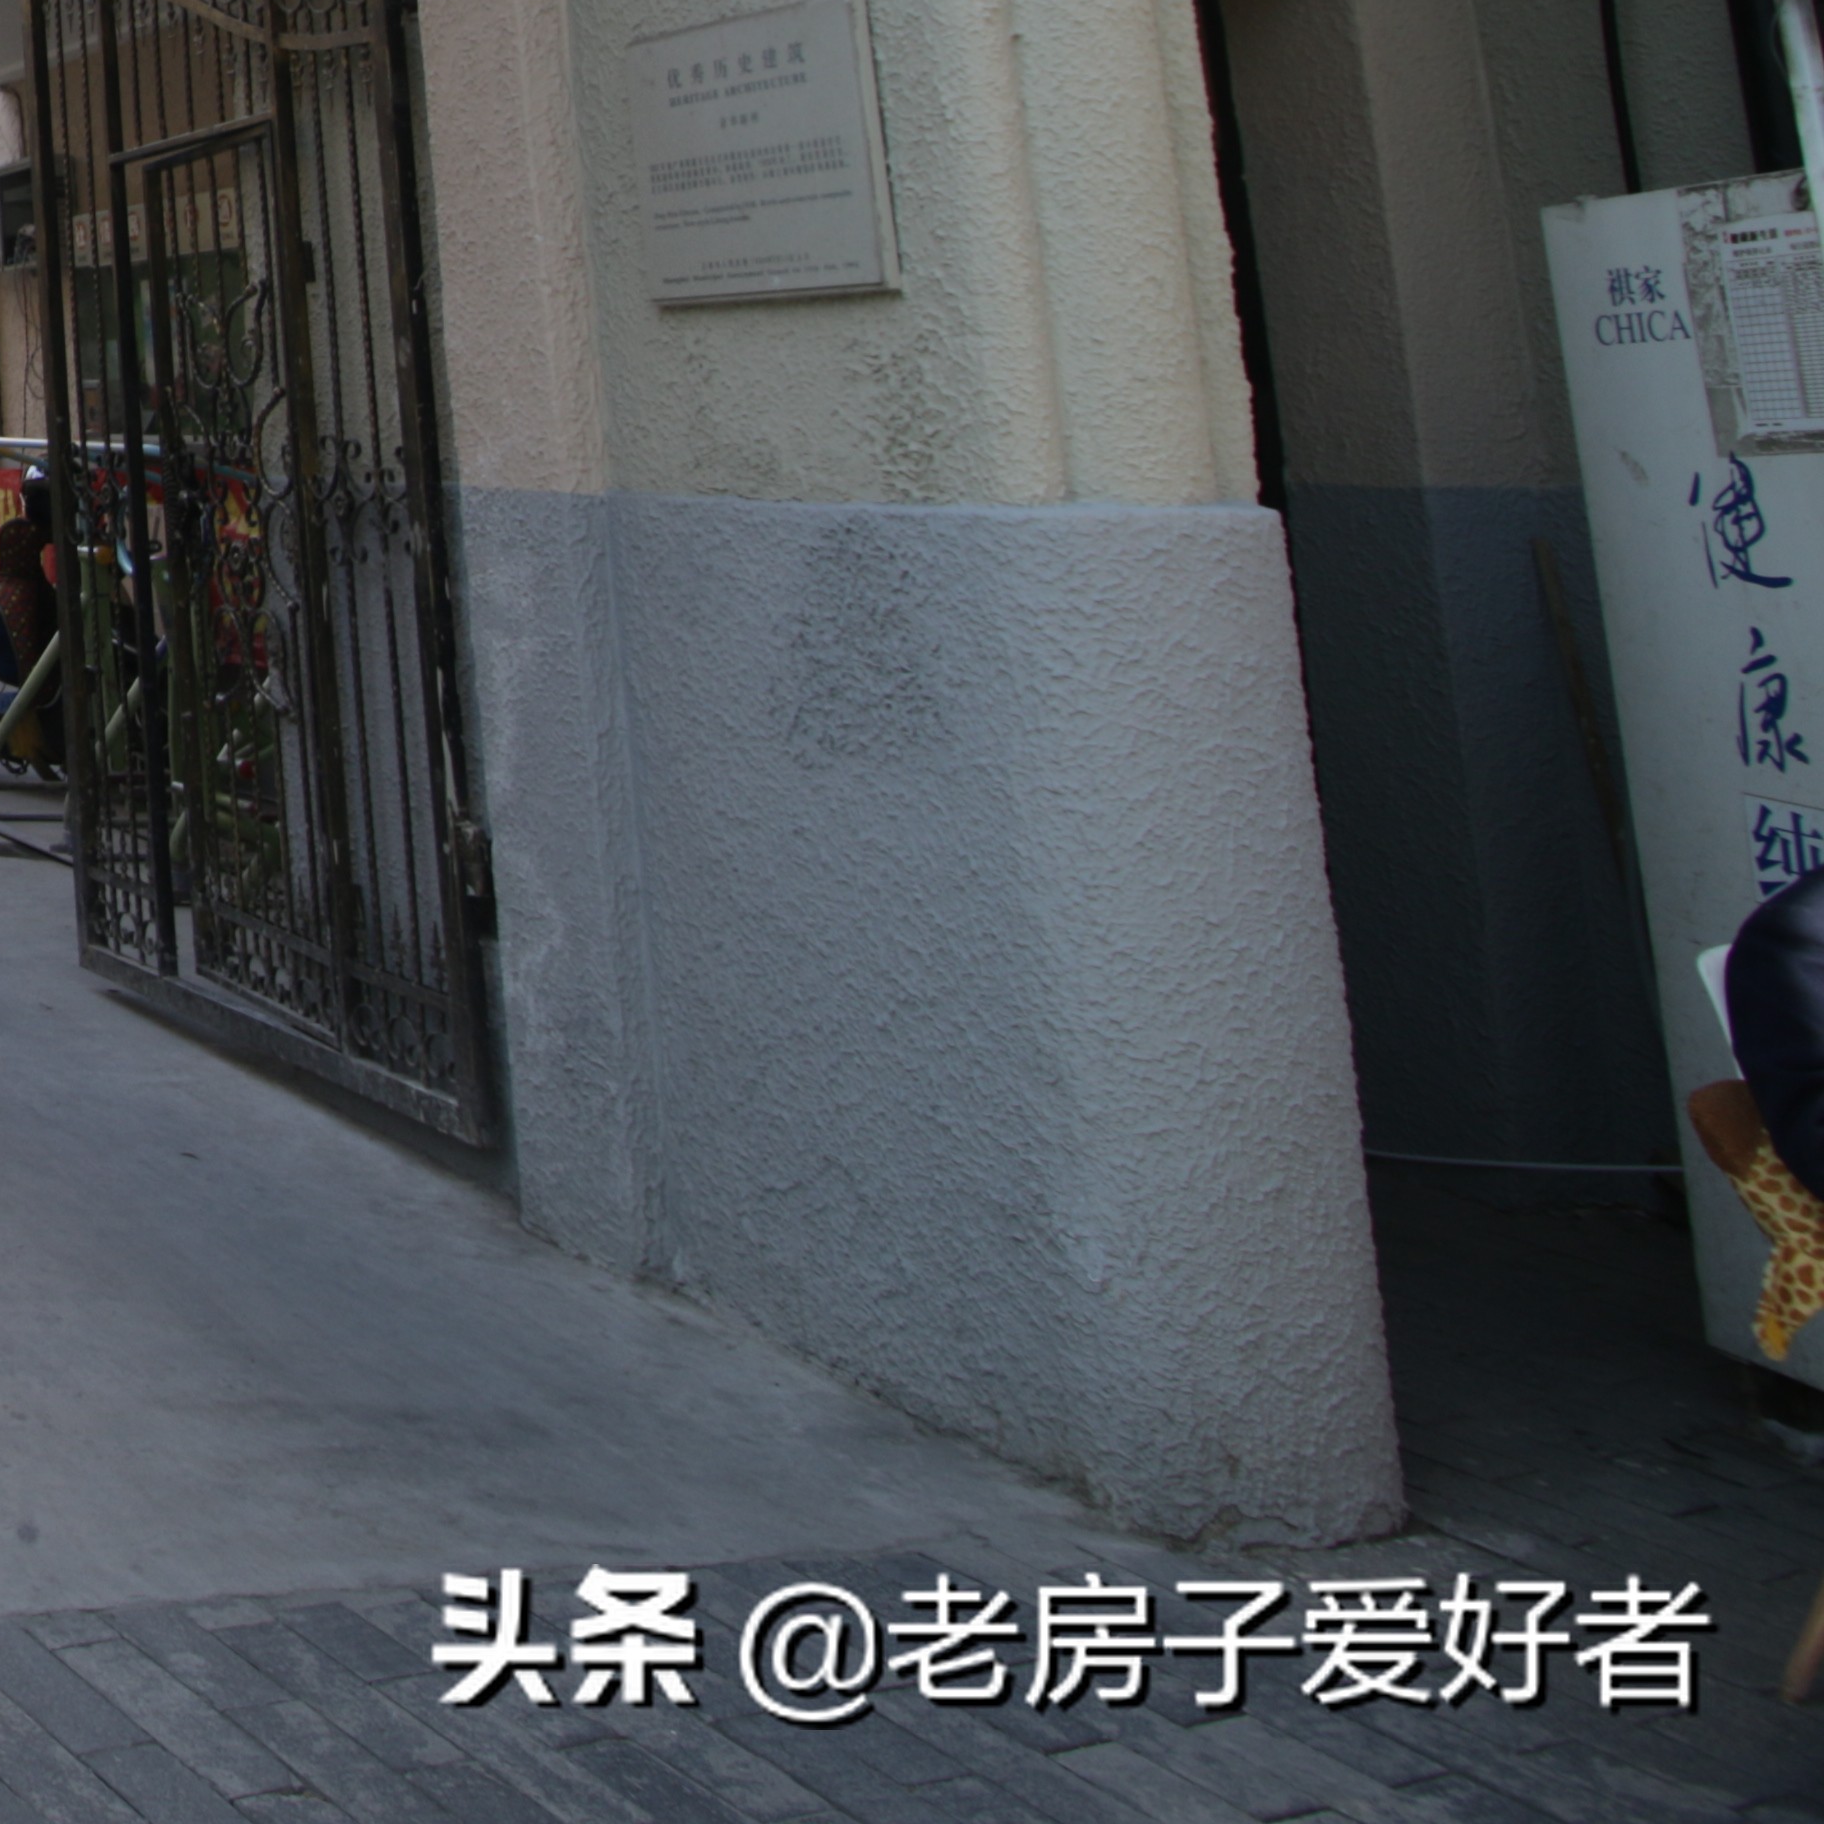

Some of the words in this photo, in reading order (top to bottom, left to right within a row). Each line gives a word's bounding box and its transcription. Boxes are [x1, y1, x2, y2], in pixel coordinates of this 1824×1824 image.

[666, 42, 806, 90] 优秀历史建筑
[1595, 309, 1692, 347] CHICA
